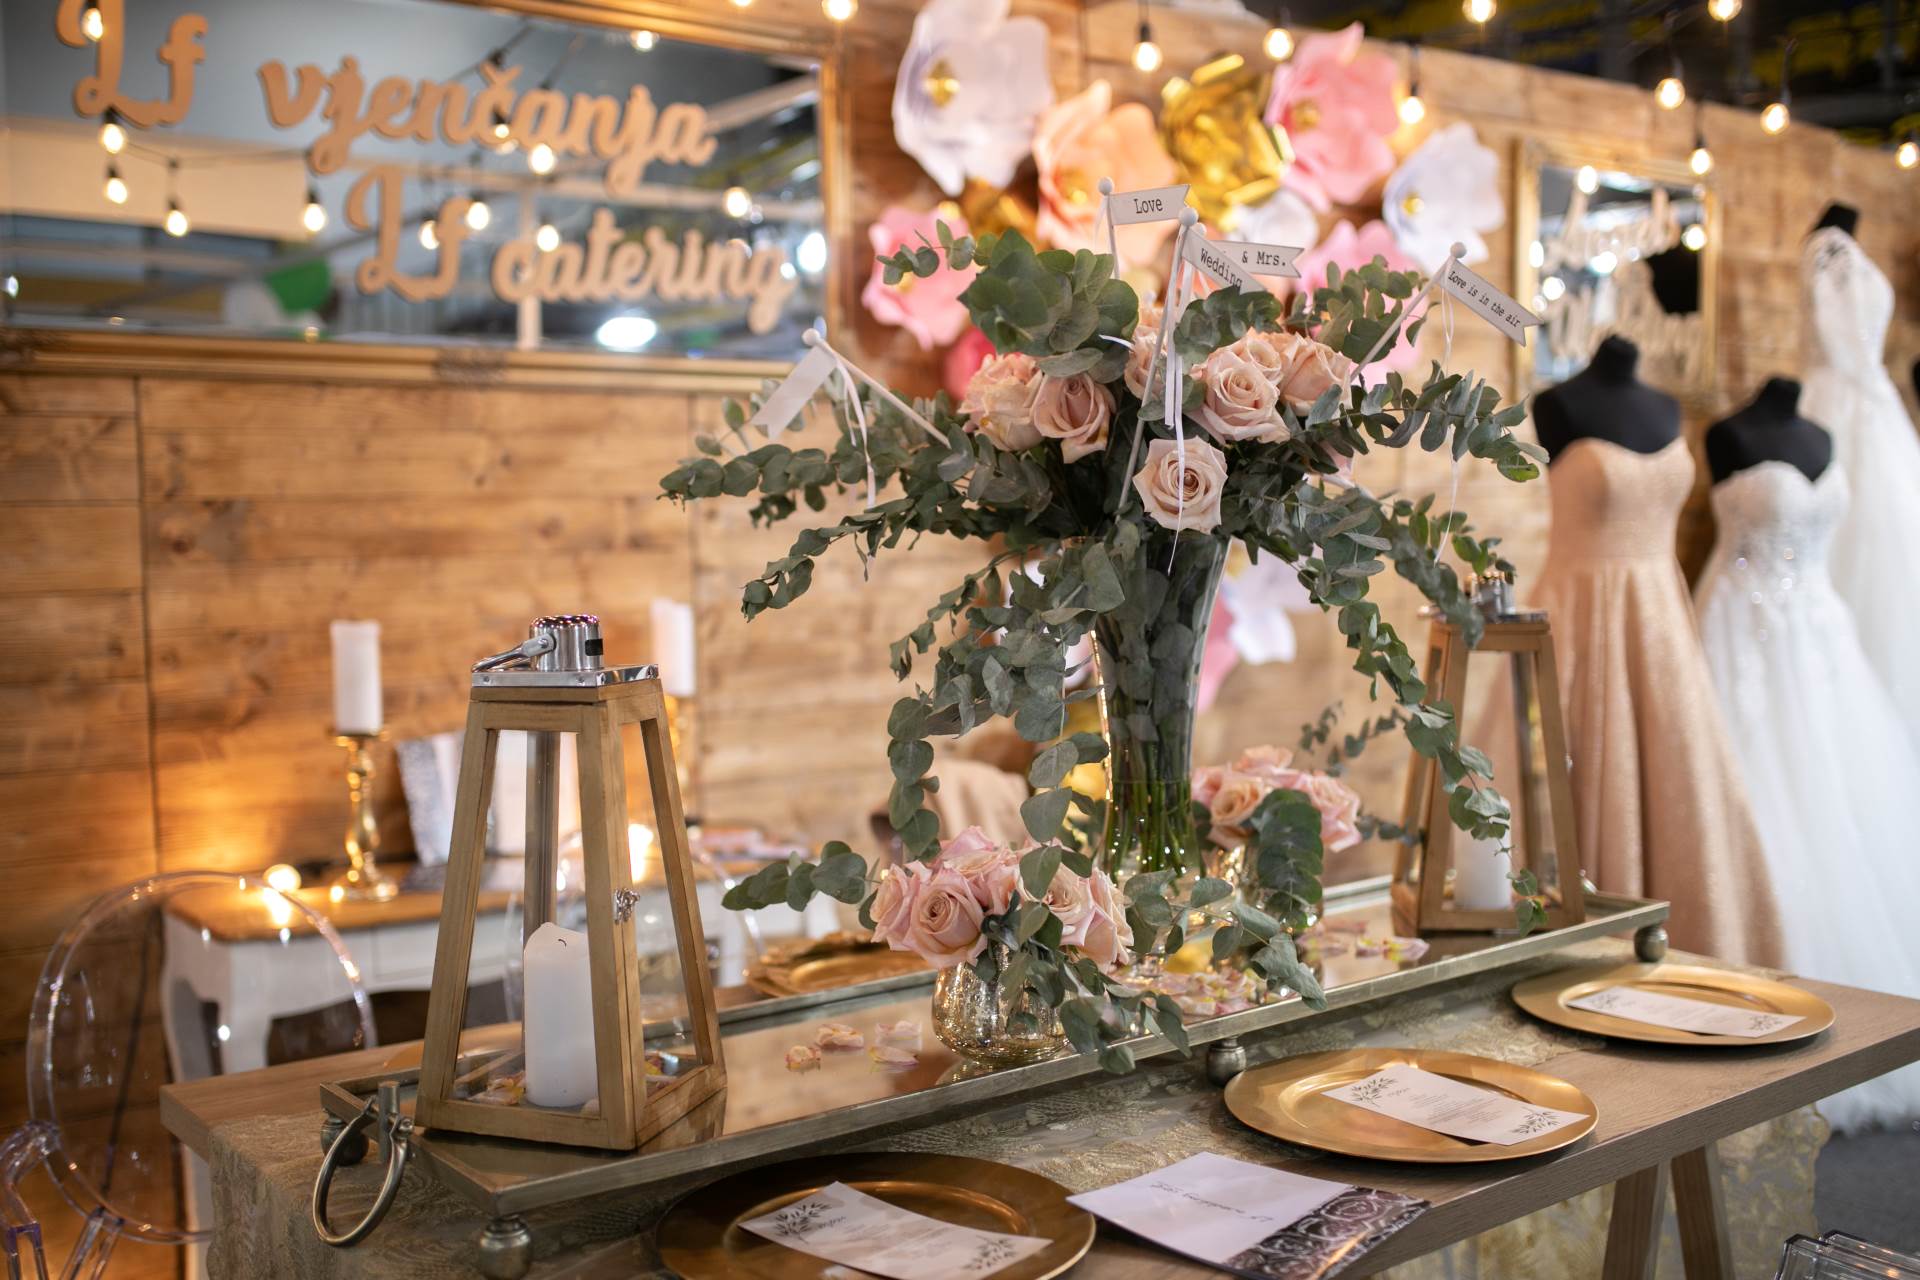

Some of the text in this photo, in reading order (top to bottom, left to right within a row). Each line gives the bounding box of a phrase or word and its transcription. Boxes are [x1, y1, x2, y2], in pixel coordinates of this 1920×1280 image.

[259, 56, 718, 197] vjenčanja
[1134, 198, 1163, 214] Love
[489, 208, 794, 335] catering
[1200, 247, 1243, 289] Wedding
[1241, 250, 1287, 267] & Mrs.
[1448, 271, 1520, 327] Love is in the air
